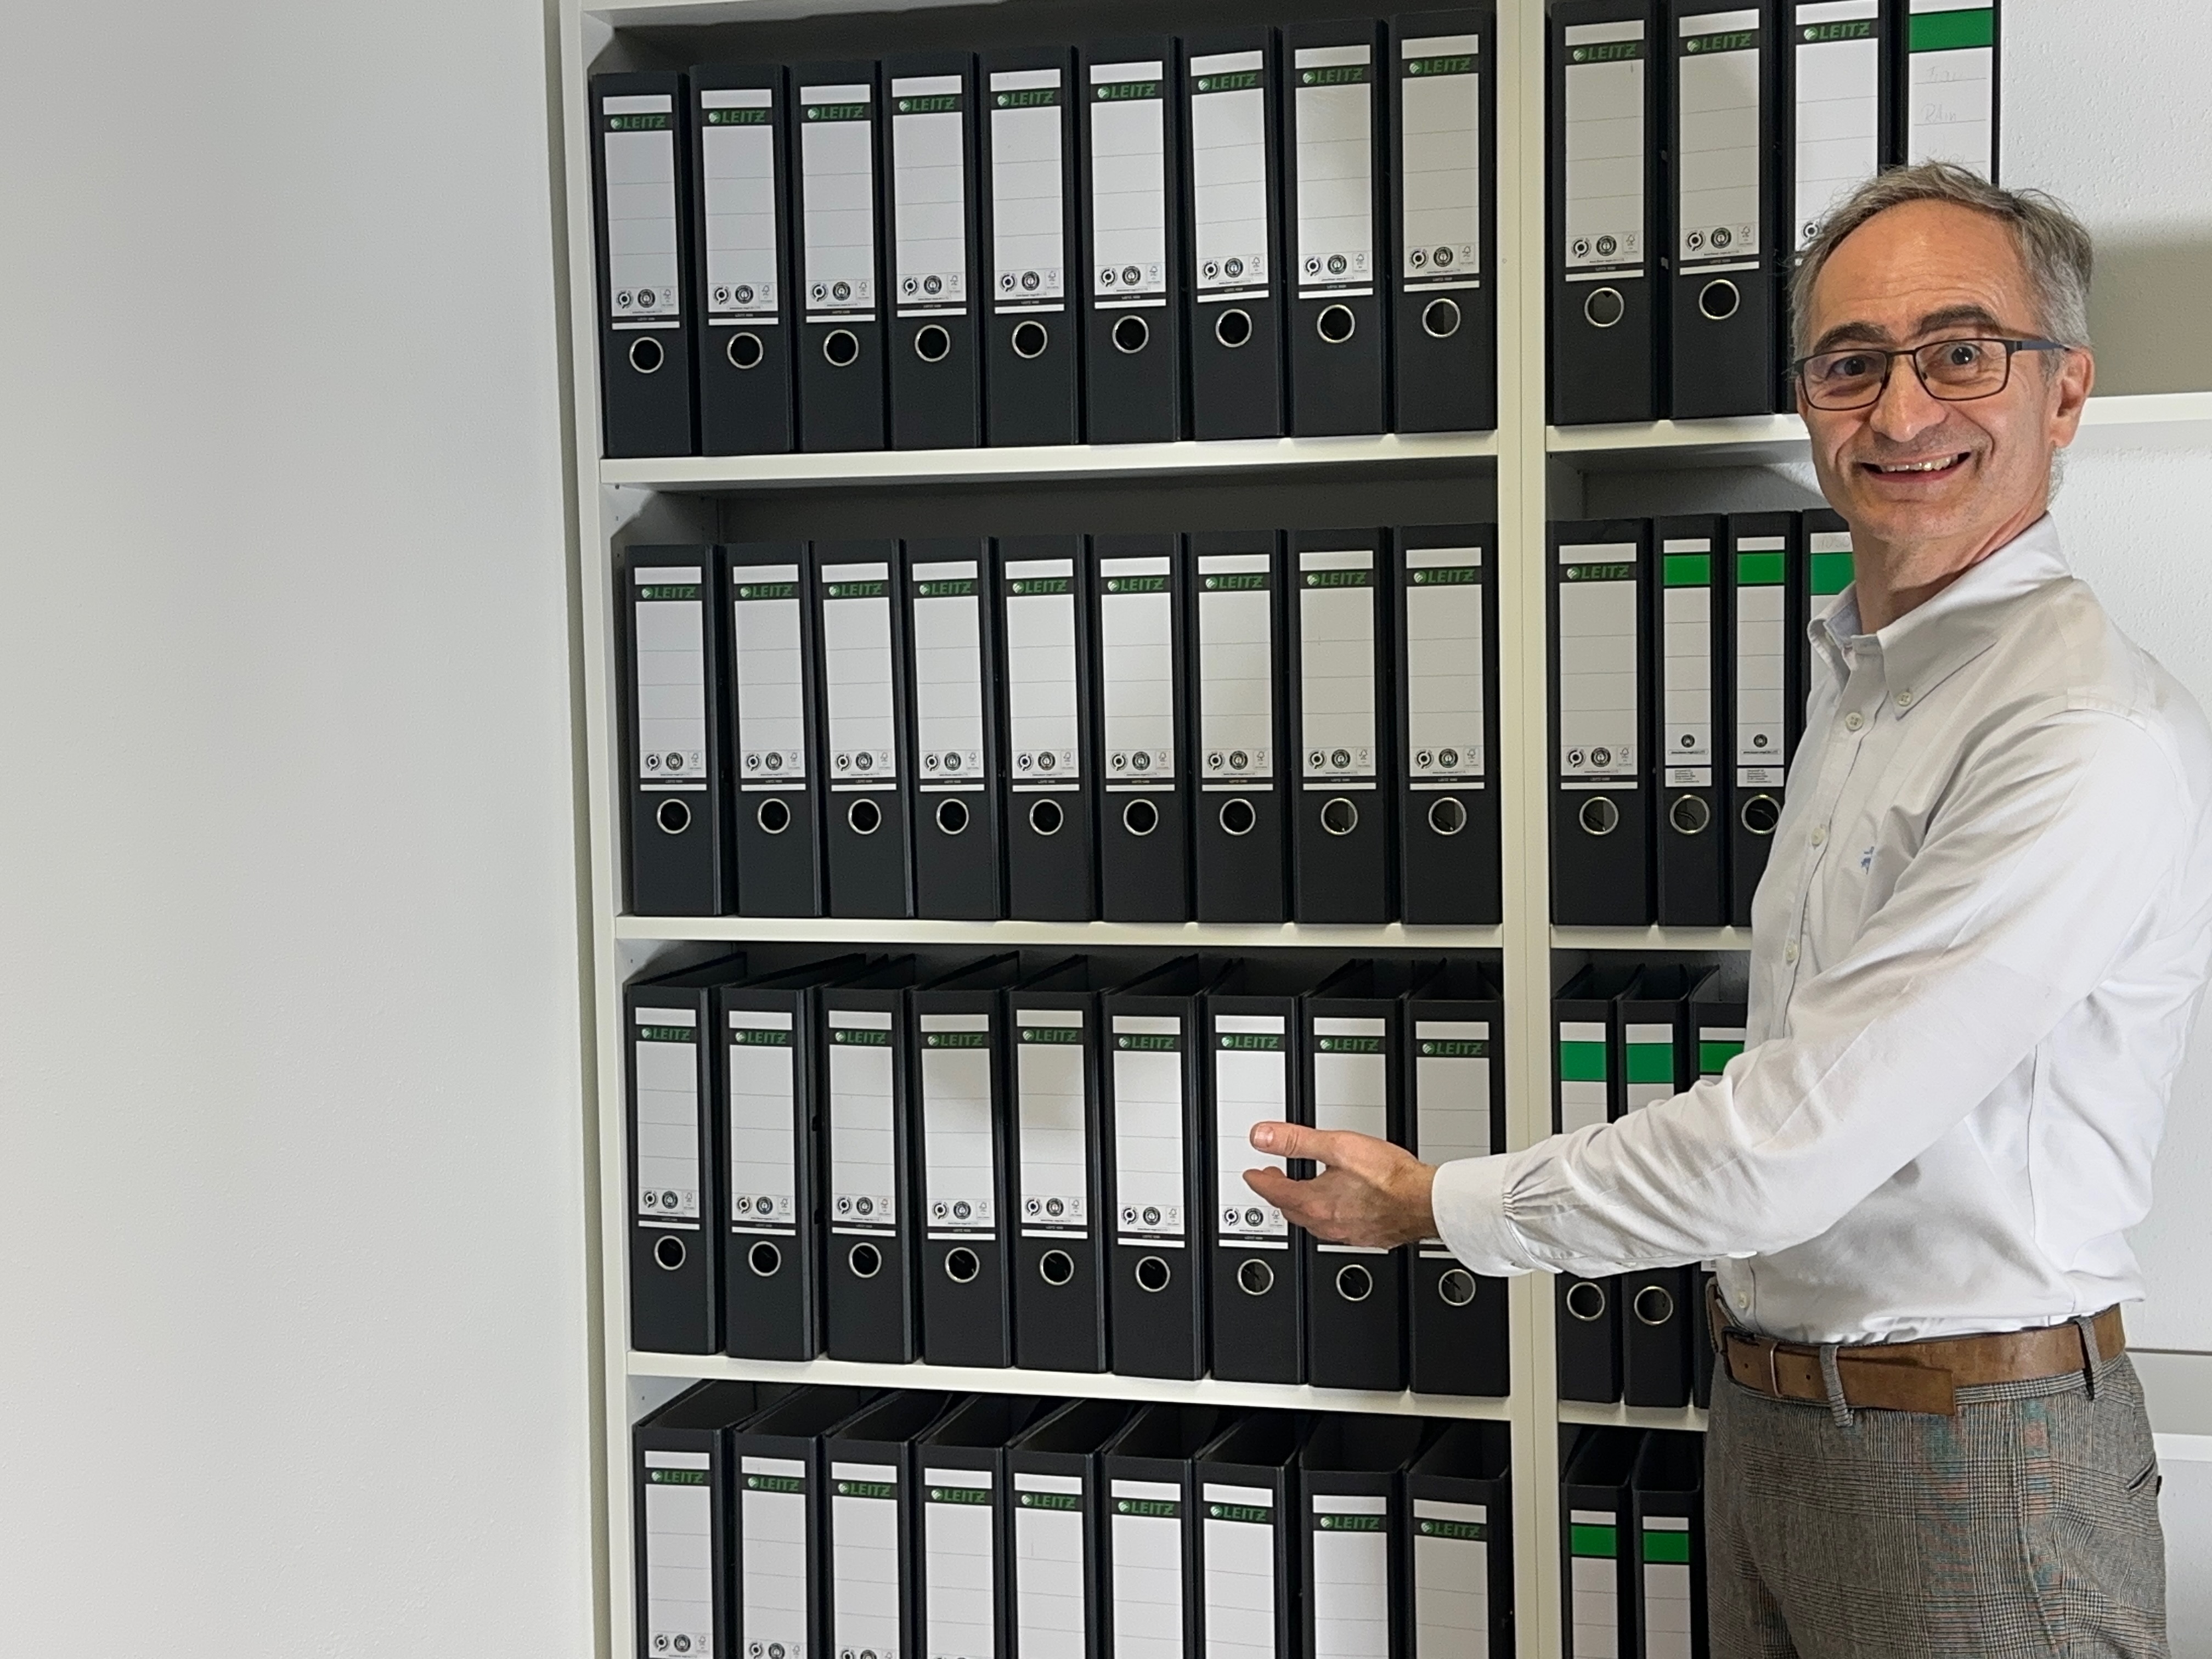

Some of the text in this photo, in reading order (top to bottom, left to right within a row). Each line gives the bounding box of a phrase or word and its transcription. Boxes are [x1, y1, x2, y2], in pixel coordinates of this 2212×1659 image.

[1820, 23, 1870, 39] LEITZ
[1703, 33, 1752, 50] LEITZ
[1589, 44, 1636, 60] LEITZ
[1425, 58, 1470, 74] LEITZ
[1212, 74, 1255, 89] LEITZ
[1317, 68, 1363, 82] LEITZ
[1111, 83, 1155, 97] LEITZ
[913, 97, 955, 111] LEITZ
[1011, 91, 1054, 105] LEITZ
[723, 110, 765, 123] LEITZ
[820, 105, 864, 119] LEITZ
[624, 115, 665, 129] LEITZ
[1429, 569, 1475, 583] LEITZ
[1582, 565, 1629, 578] LEITZ
[1121, 578, 1164, 590] LEITZ
[1220, 575, 1263, 588] LEITZ
[1322, 572, 1366, 585] LEITZ
[655, 586, 696, 597] LEITZ
[753, 584, 793, 597] LEITZ
[842, 583, 882, 596] LEITZ
[932, 581, 971, 595] LEITZ
[1026, 579, 1066, 592] LEITZ
[653, 1028, 689, 1040] LEITZ
[748, 1031, 787, 1044] LEITZ
[847, 1031, 885, 1043] LEITZ
[941, 1035, 983, 1045] LEITZ
[1036, 1030, 1077, 1041] LEITZ
[1132, 1036, 1173, 1048] LEITZ
[1234, 1035, 1278, 1048] LEITZ
[1334, 1039, 1378, 1050] LEITZ
[1436, 1043, 1482, 1054] LEITZ
[664, 1471, 704, 1483] LEITZ
[760, 1477, 799, 1491] LEITZ
[851, 1483, 890, 1496] LEITZ
[946, 1489, 985, 1502] LEITZ
[1035, 1495, 1075, 1508] LEITZ
[1131, 1501, 1173, 1515] LEITZ
[1223, 1506, 1266, 1520] LEITZ
[1334, 1516, 1378, 1529] LEITZ
[1435, 1523, 1480, 1538] LEITZ
